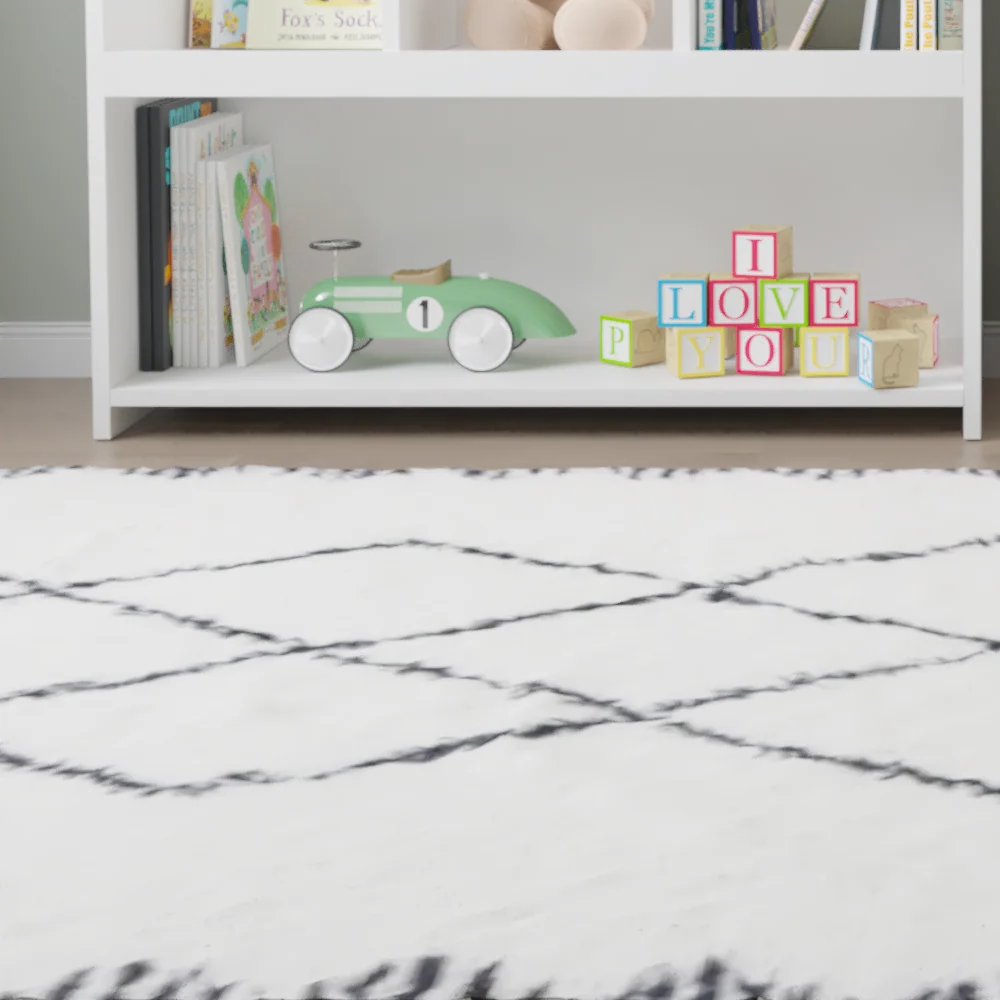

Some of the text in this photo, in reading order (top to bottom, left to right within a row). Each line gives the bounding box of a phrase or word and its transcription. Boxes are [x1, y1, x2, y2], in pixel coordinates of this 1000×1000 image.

[281, 8, 382, 28] Fox's Sock
[904, 31, 915, 51] he
[922, 31, 933, 51] he
[746, 239, 762, 272] I
[419, 300, 429, 329] 1
[609, 326, 624, 355] P
